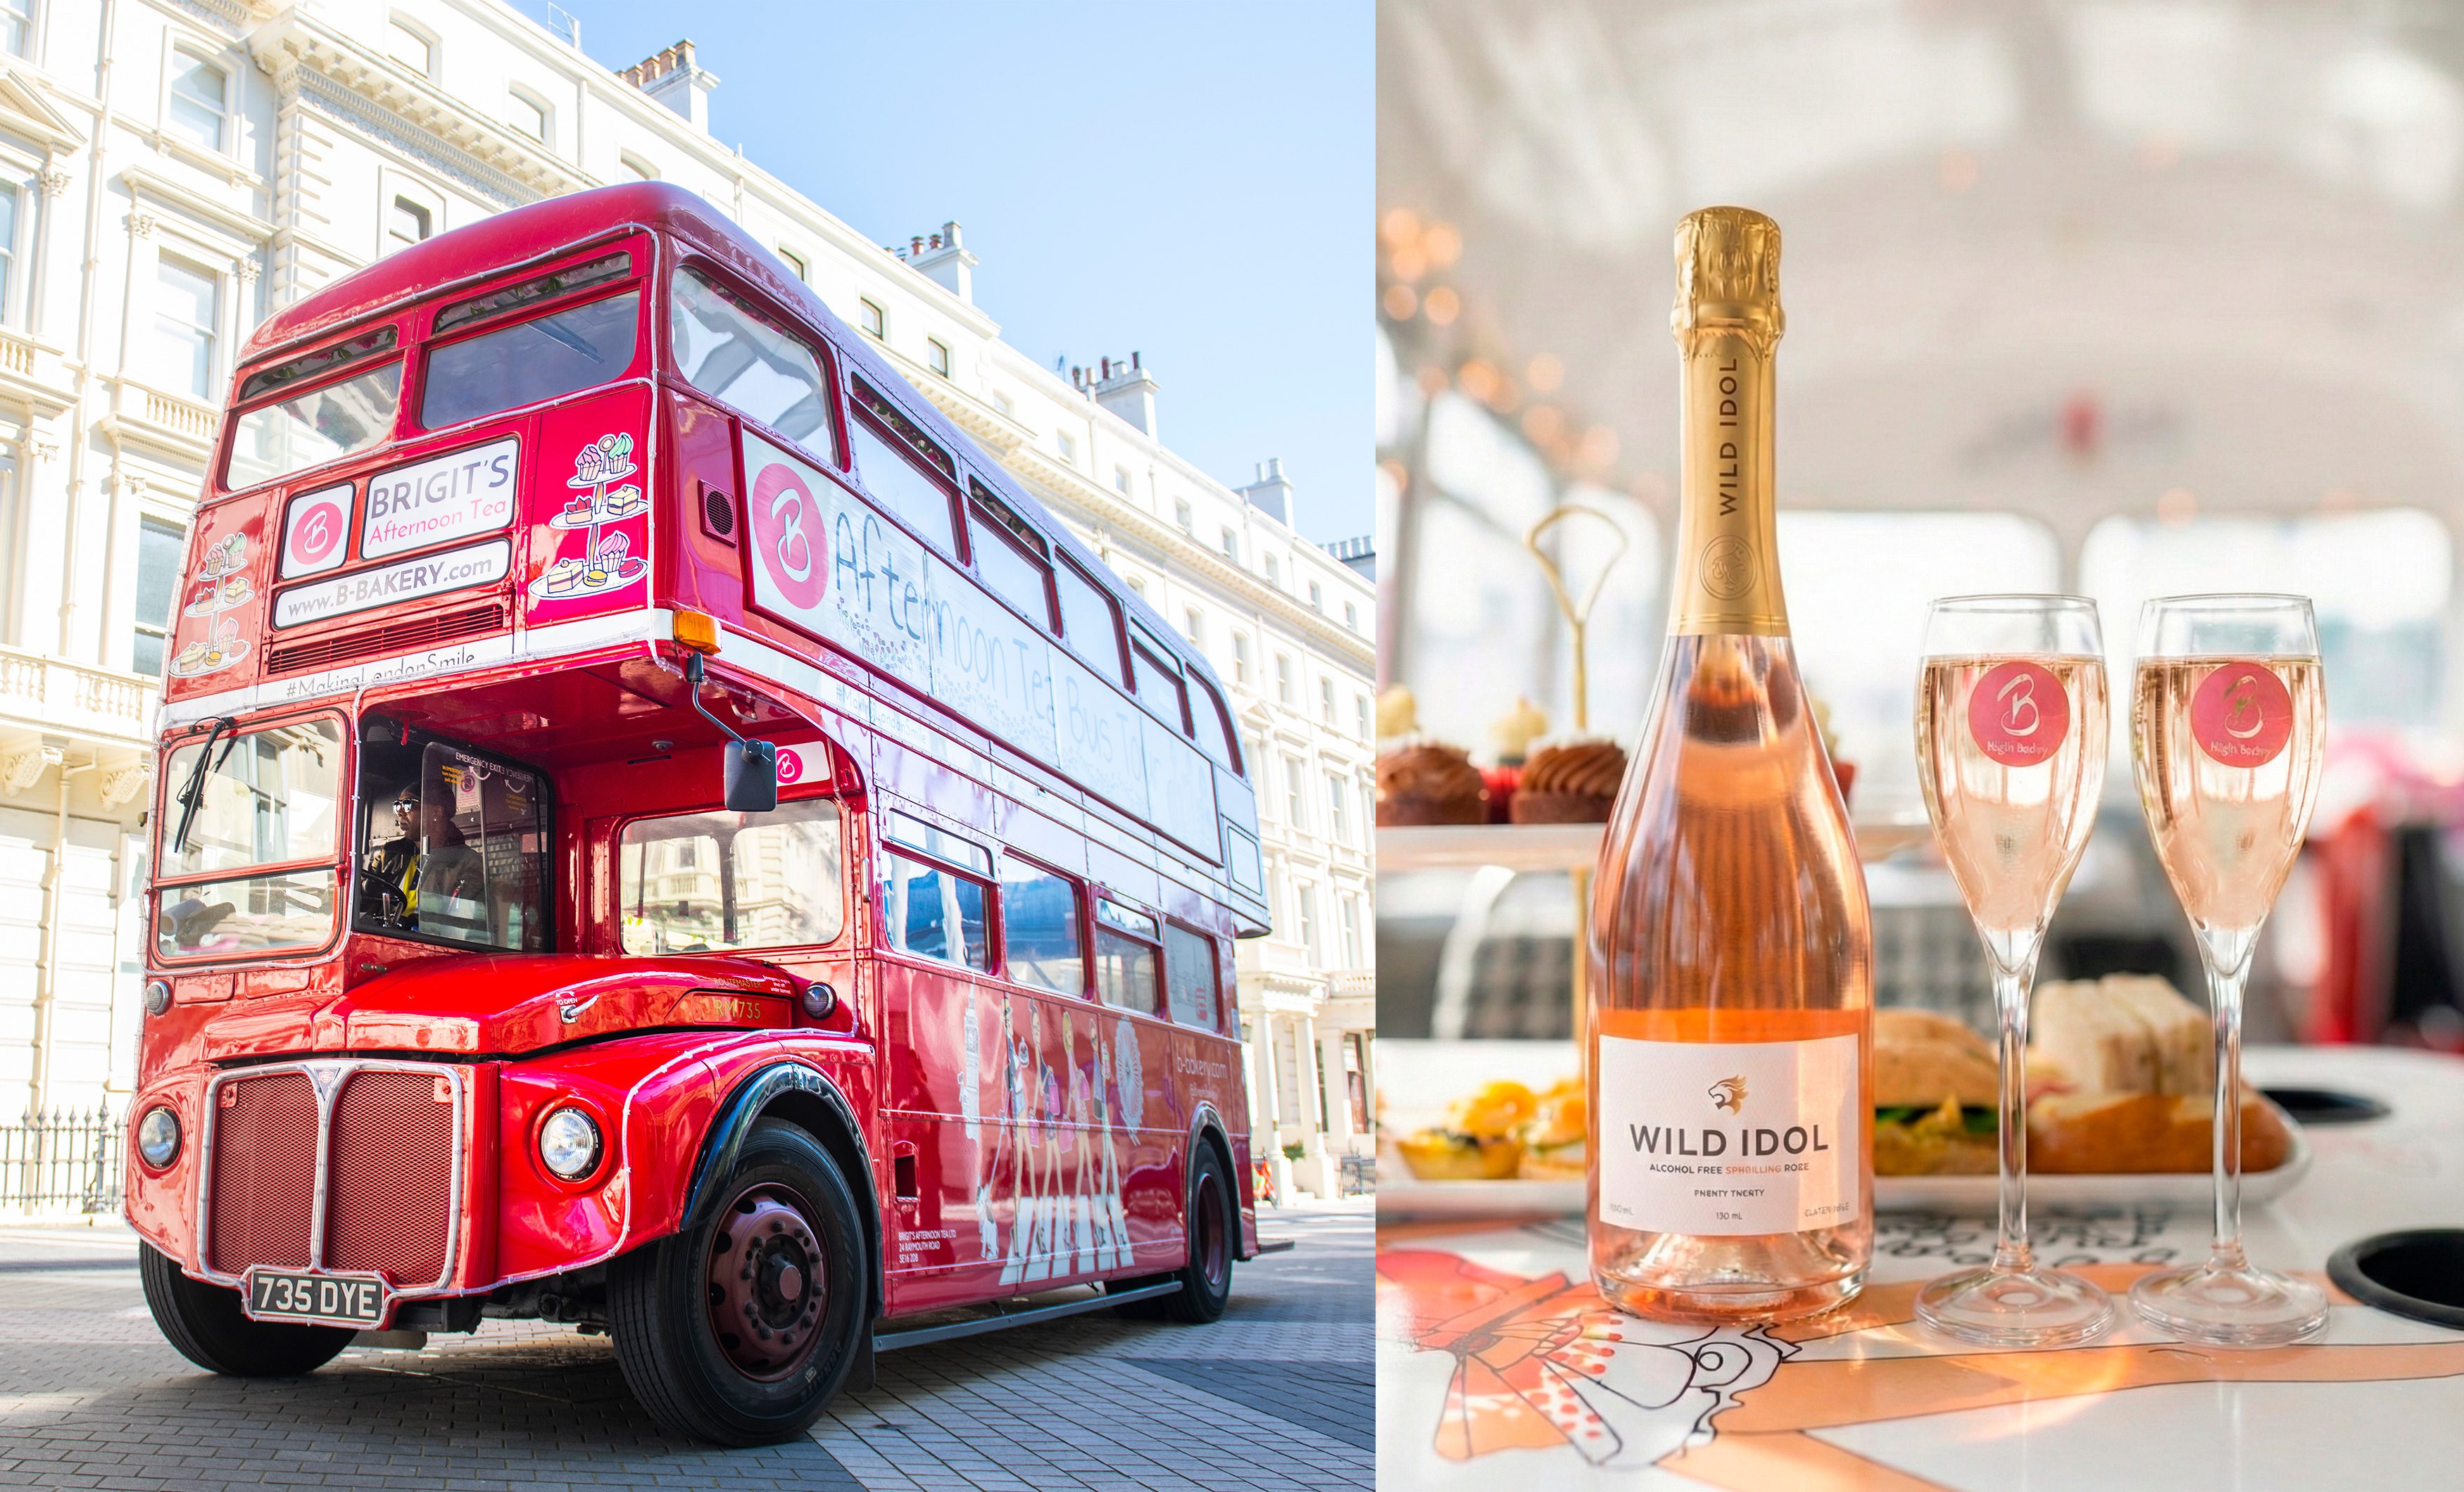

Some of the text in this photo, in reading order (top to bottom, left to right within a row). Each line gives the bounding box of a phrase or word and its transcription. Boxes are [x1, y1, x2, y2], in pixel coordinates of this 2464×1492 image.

[1718, 358, 1737, 517] WILD IDOL
[370, 454, 510, 519] BRIGIT'S
[368, 498, 506, 546] Afternoon Tea
[288, 558, 492, 618] www.B-BAKERY.com
[1065, 675, 1114, 764] Bus
[455, 752, 489, 769] EMERGENCY
[714, 978, 762, 988] ROUTEMASTER
[1629, 1123, 1829, 1157] WILD IDOL
[1649, 1163, 1695, 1175] ALCOHOL
[1697, 1166, 1723, 1175] FREE
[898, 1243, 905, 1253] 24
[929, 1240, 941, 1250] ROAD
[915, 1229, 941, 1240] AFTERNOON
[258, 1277, 377, 1317] 735 DYE
